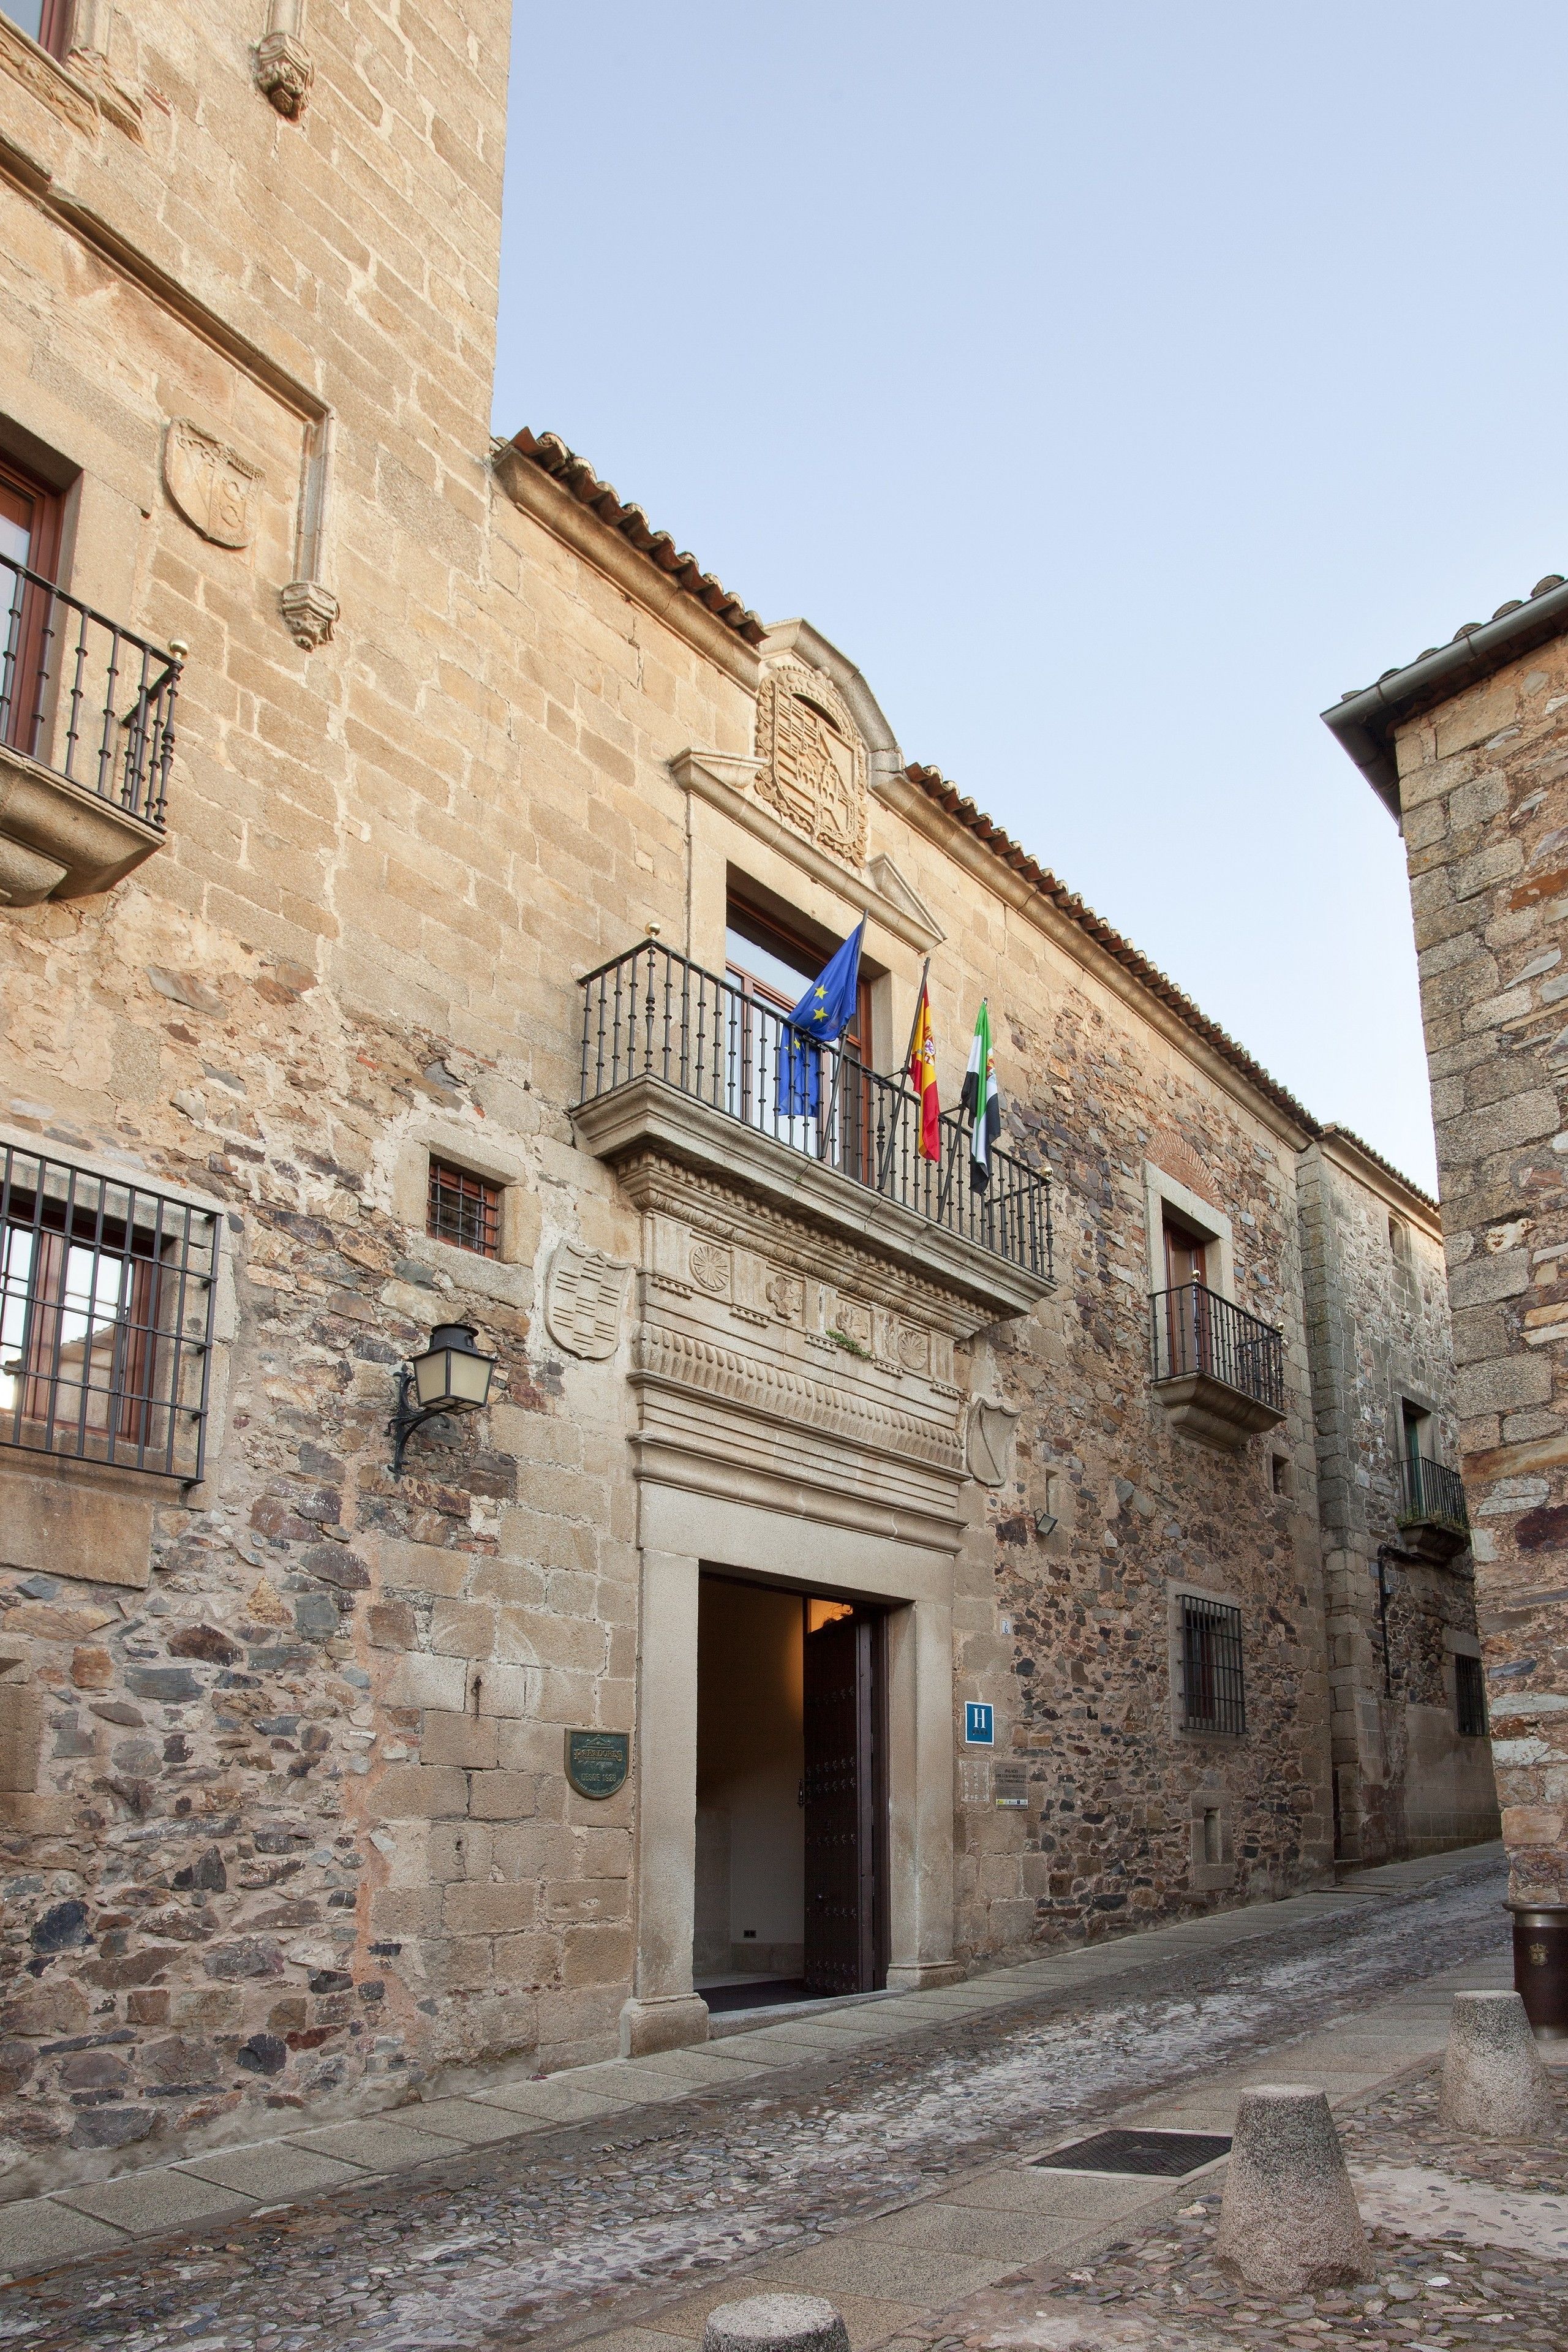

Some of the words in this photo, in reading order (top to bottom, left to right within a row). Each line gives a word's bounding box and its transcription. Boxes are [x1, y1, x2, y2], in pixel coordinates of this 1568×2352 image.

[973, 1708, 986, 1729] H
[573, 1749, 624, 1762] PARADORES
[581, 1773, 600, 1782] DESDE
